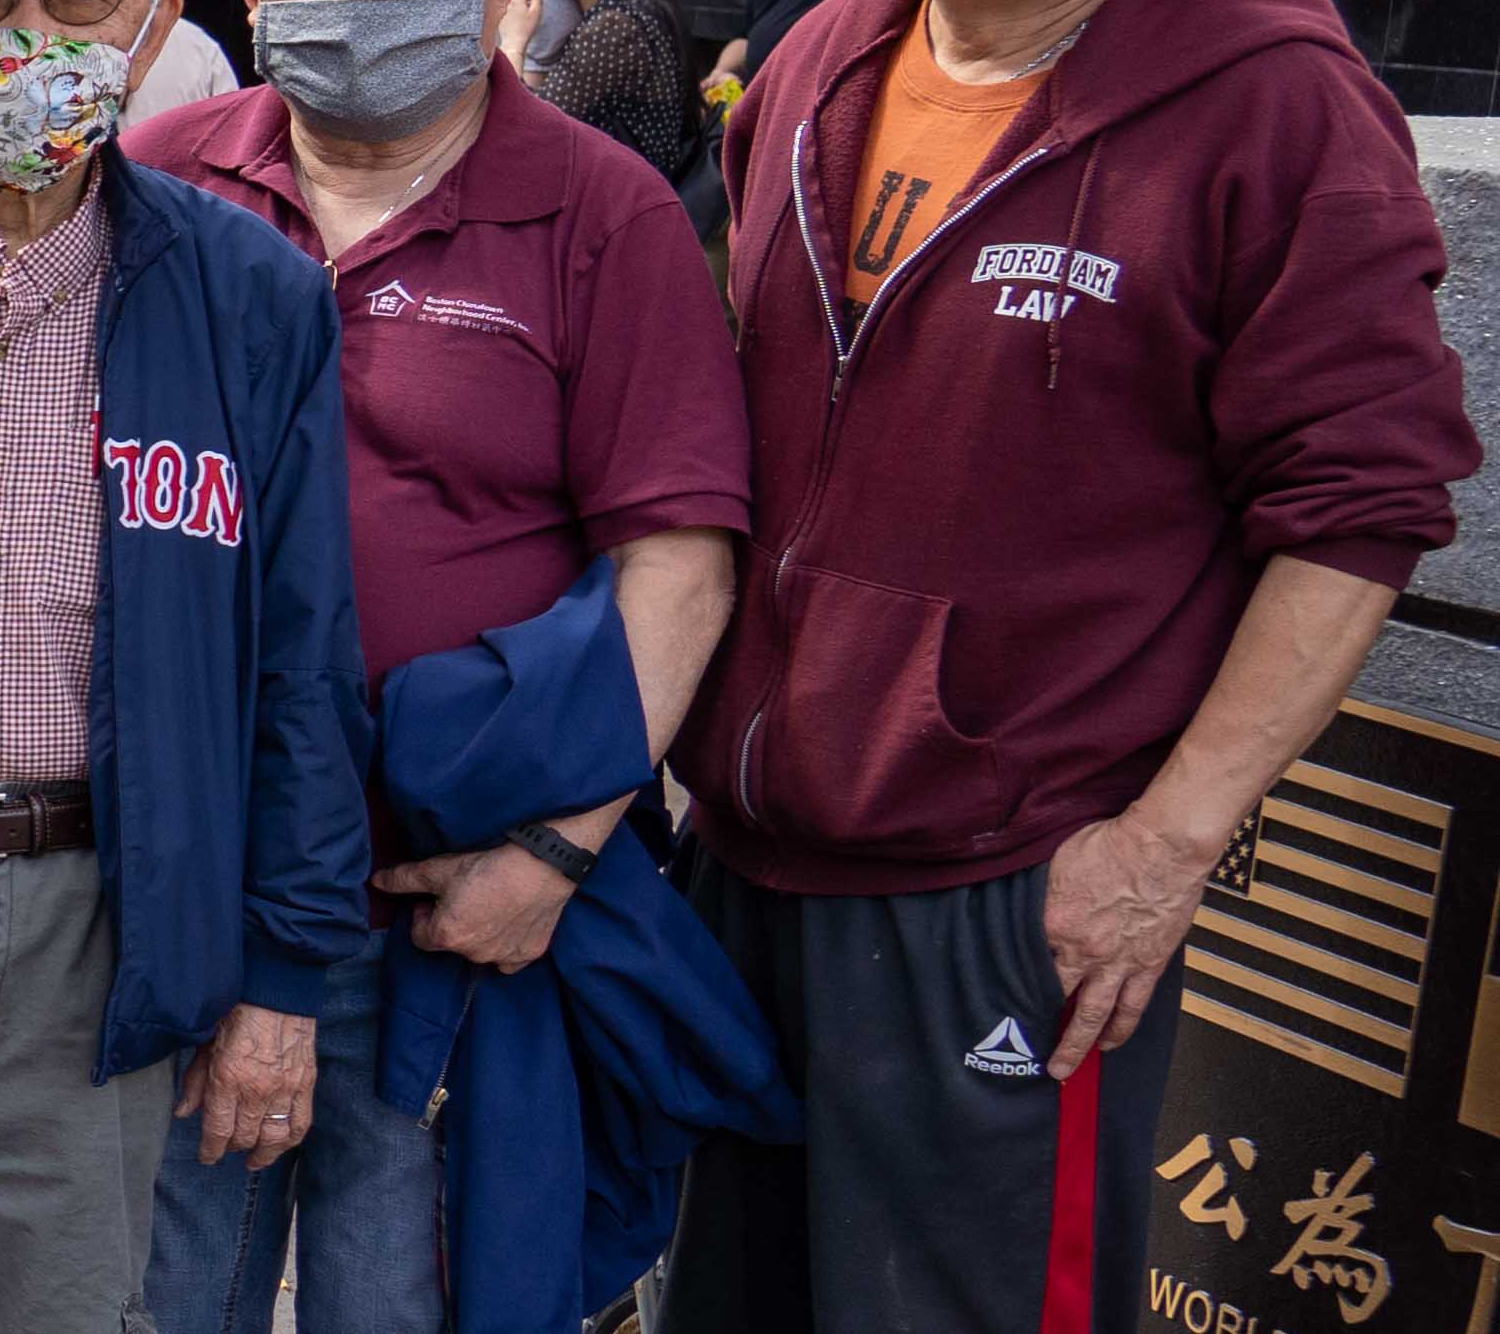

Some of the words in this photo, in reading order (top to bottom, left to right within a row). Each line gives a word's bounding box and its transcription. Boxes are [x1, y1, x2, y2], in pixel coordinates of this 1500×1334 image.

[422, 304, 486, 320] Neighborhood
[425, 295, 455, 307] Boston
[456, 299, 504, 314] Chinatown
[994, 285, 1077, 323] LAW
[964, 1052, 1041, 1076] Reebok
